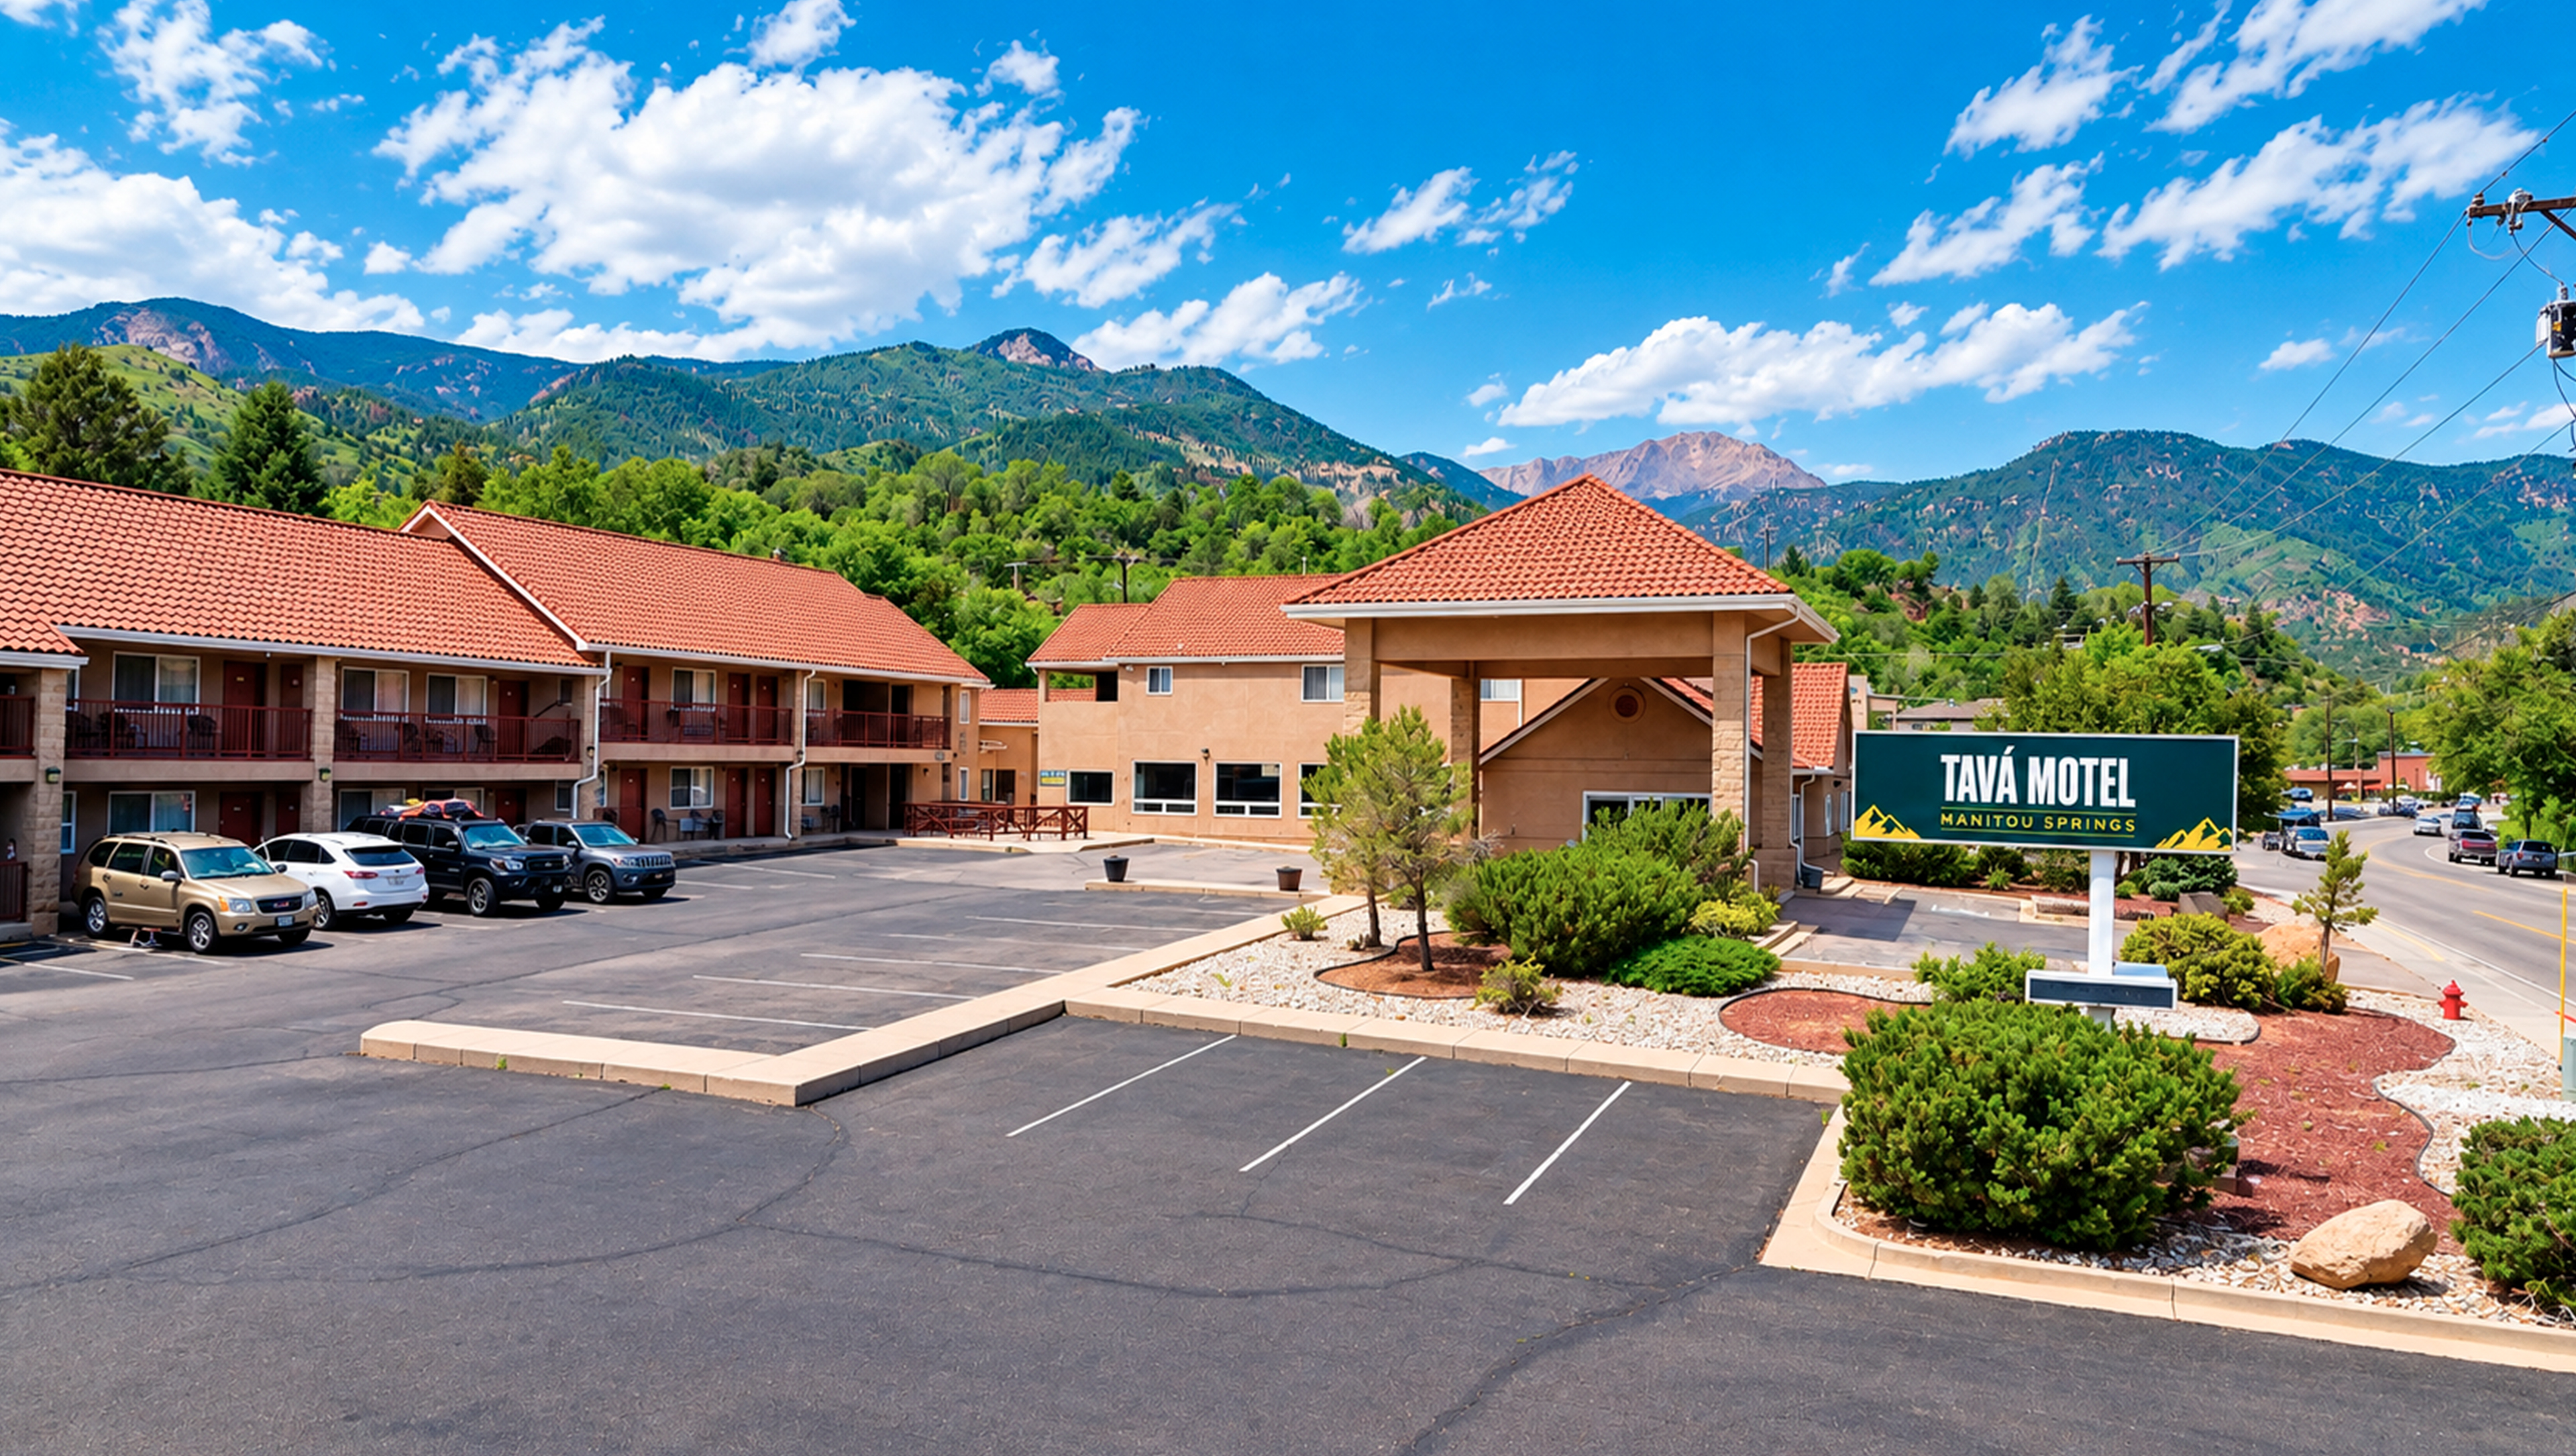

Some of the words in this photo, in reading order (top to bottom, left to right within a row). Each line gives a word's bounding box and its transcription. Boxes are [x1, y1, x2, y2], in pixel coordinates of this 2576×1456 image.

[1940, 745, 2018, 804] TAVÁ
[2027, 756, 2136, 808] MOTEL
[1941, 813, 2033, 828] MANITOU
[2044, 816, 2135, 832] SPRINGS
